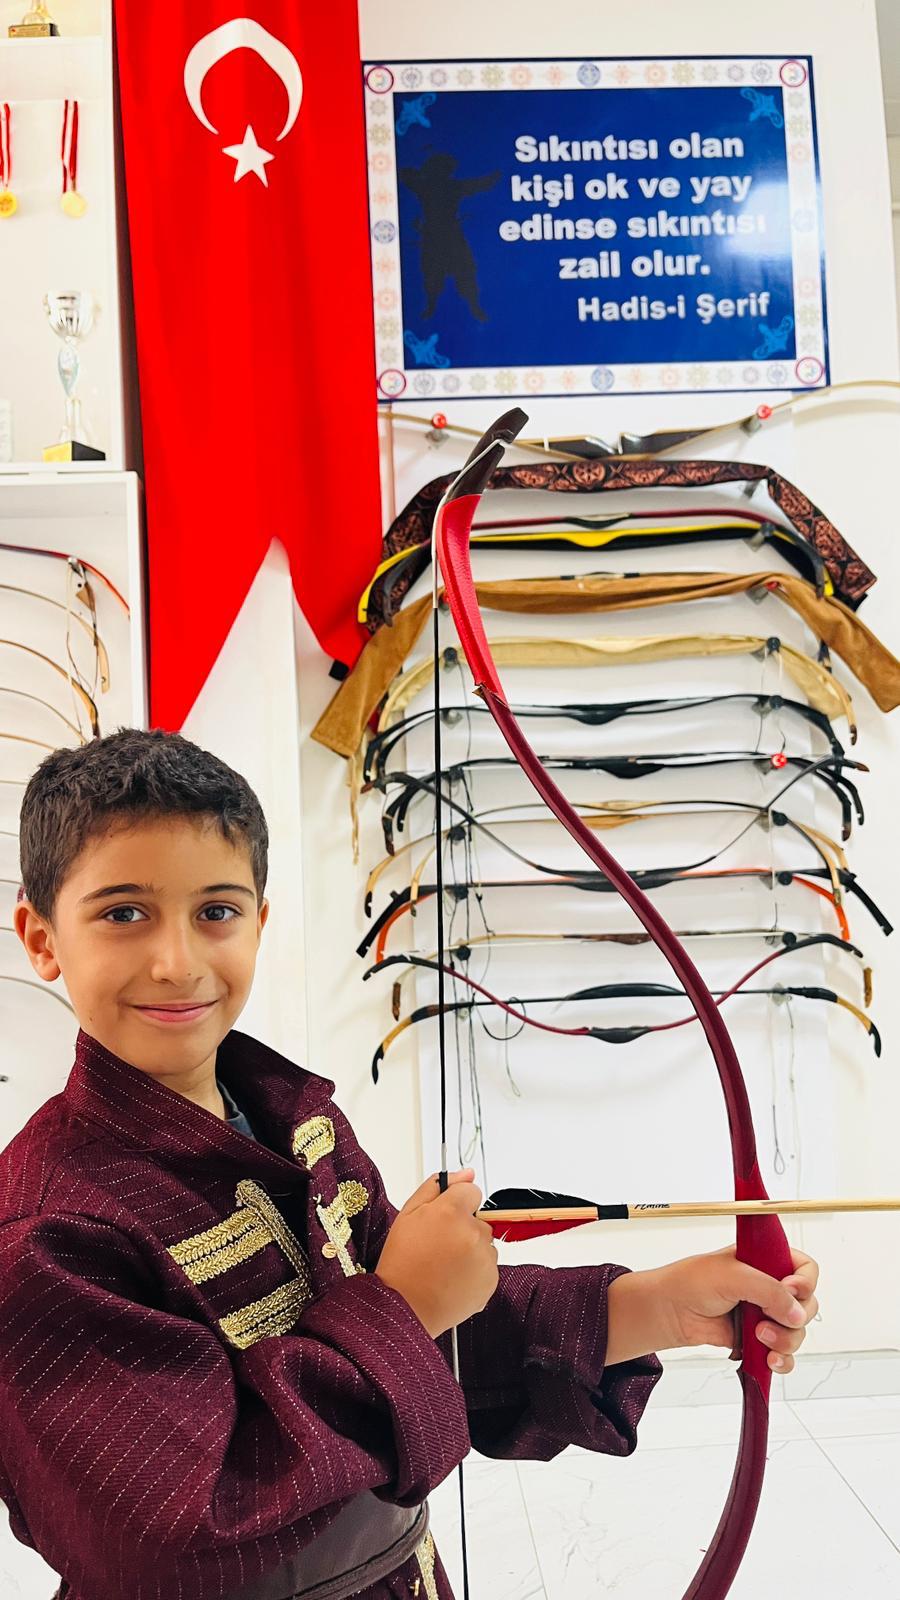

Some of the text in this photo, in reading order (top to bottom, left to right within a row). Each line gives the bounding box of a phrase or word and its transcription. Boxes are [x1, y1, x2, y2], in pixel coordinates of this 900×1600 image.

[515, 132, 744, 163] Sıkıntısı olan
[511, 172, 752, 208] kişi ok ve yay
[499, 209, 767, 242] edinse sıkıntısı
[559, 249, 711, 279] zail olur.
[577, 291, 771, 325] Hadis-i Şerif
